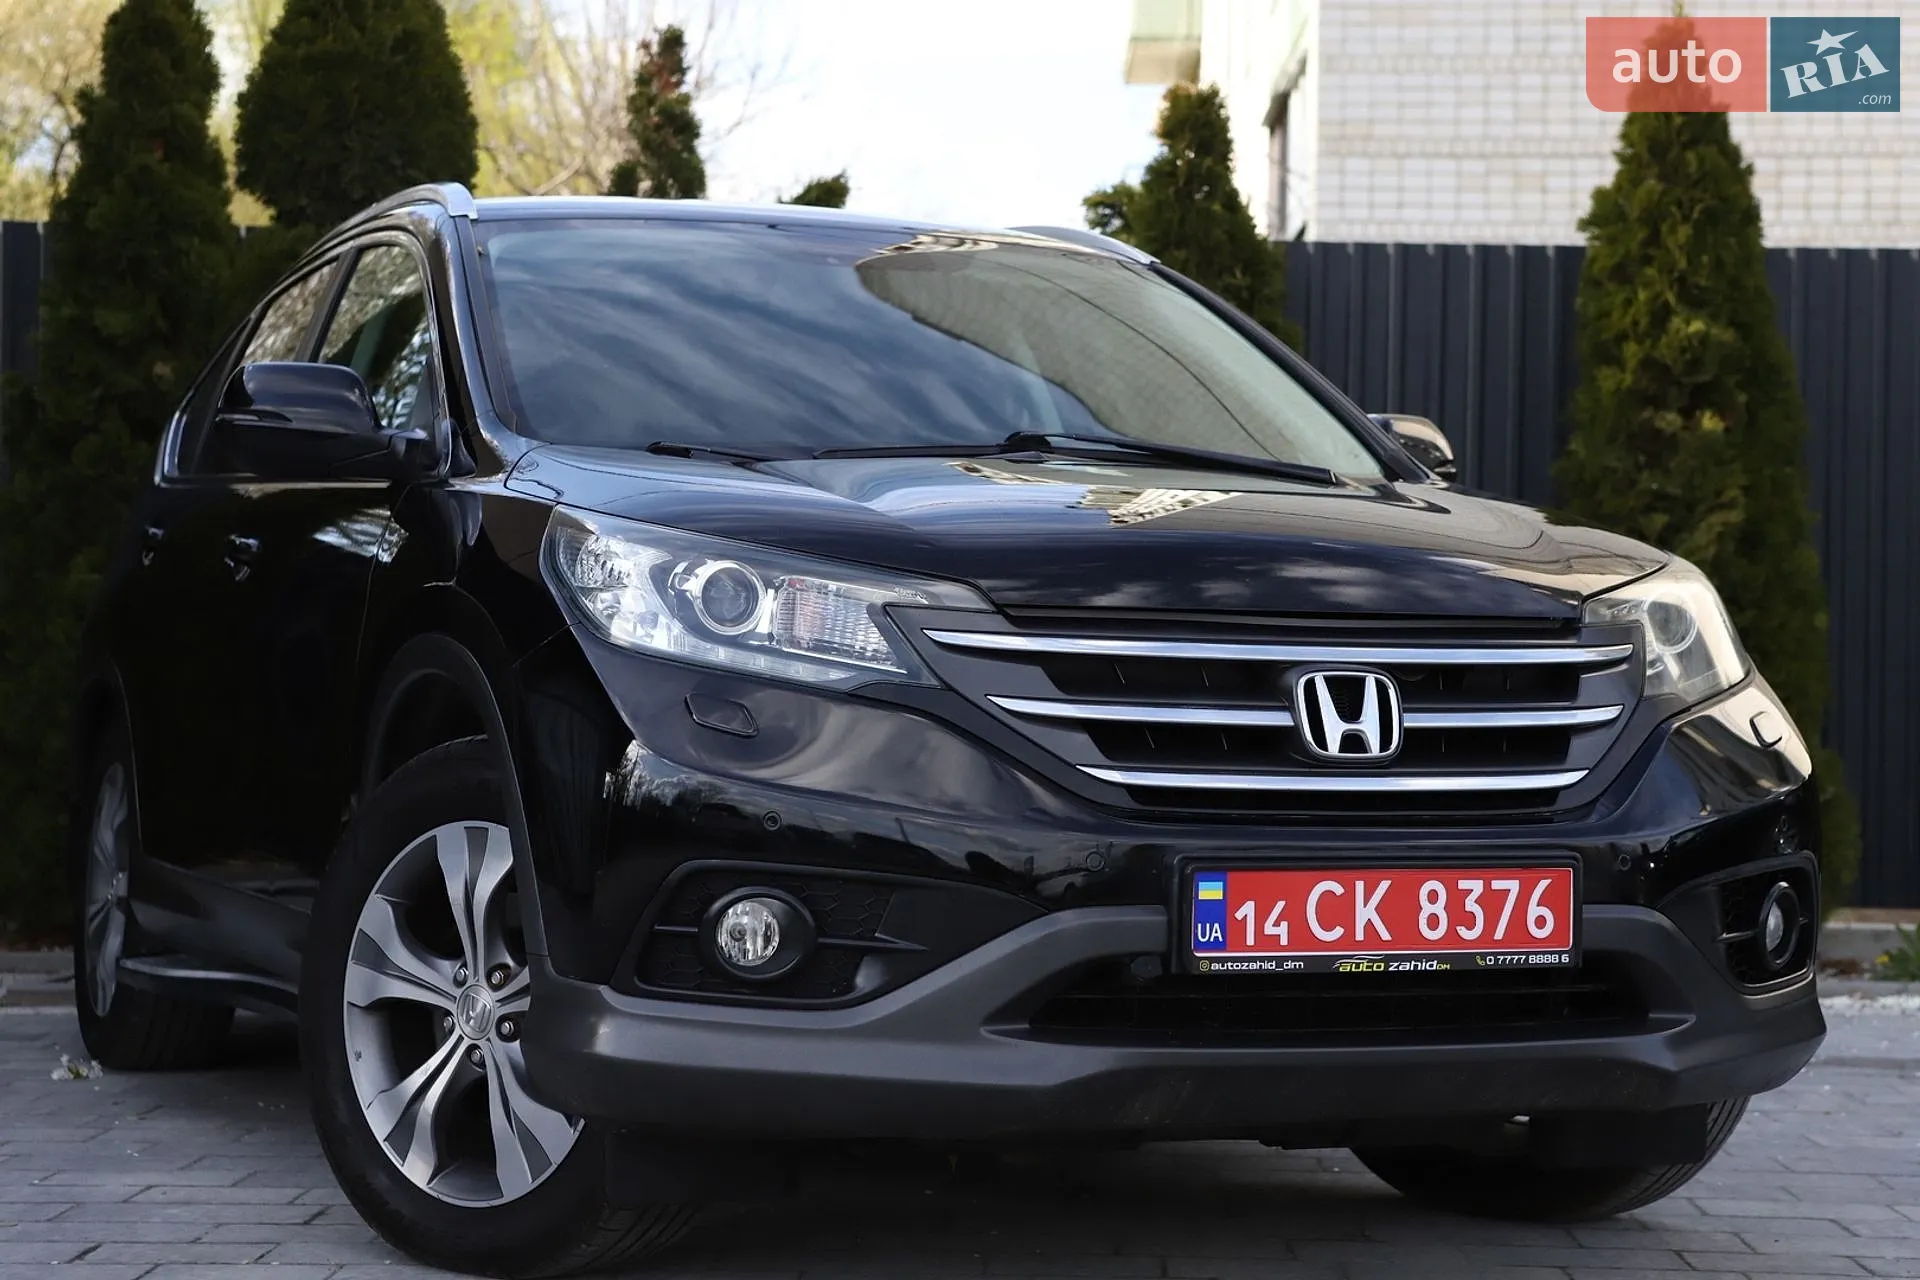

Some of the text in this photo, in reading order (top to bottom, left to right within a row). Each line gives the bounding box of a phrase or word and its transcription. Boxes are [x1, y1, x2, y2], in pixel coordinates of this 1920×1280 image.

[1234, 878, 1555, 946] 14 CK 8376
[1197, 923, 1223, 942] UA
[1339, 961, 1385, 972] auto
